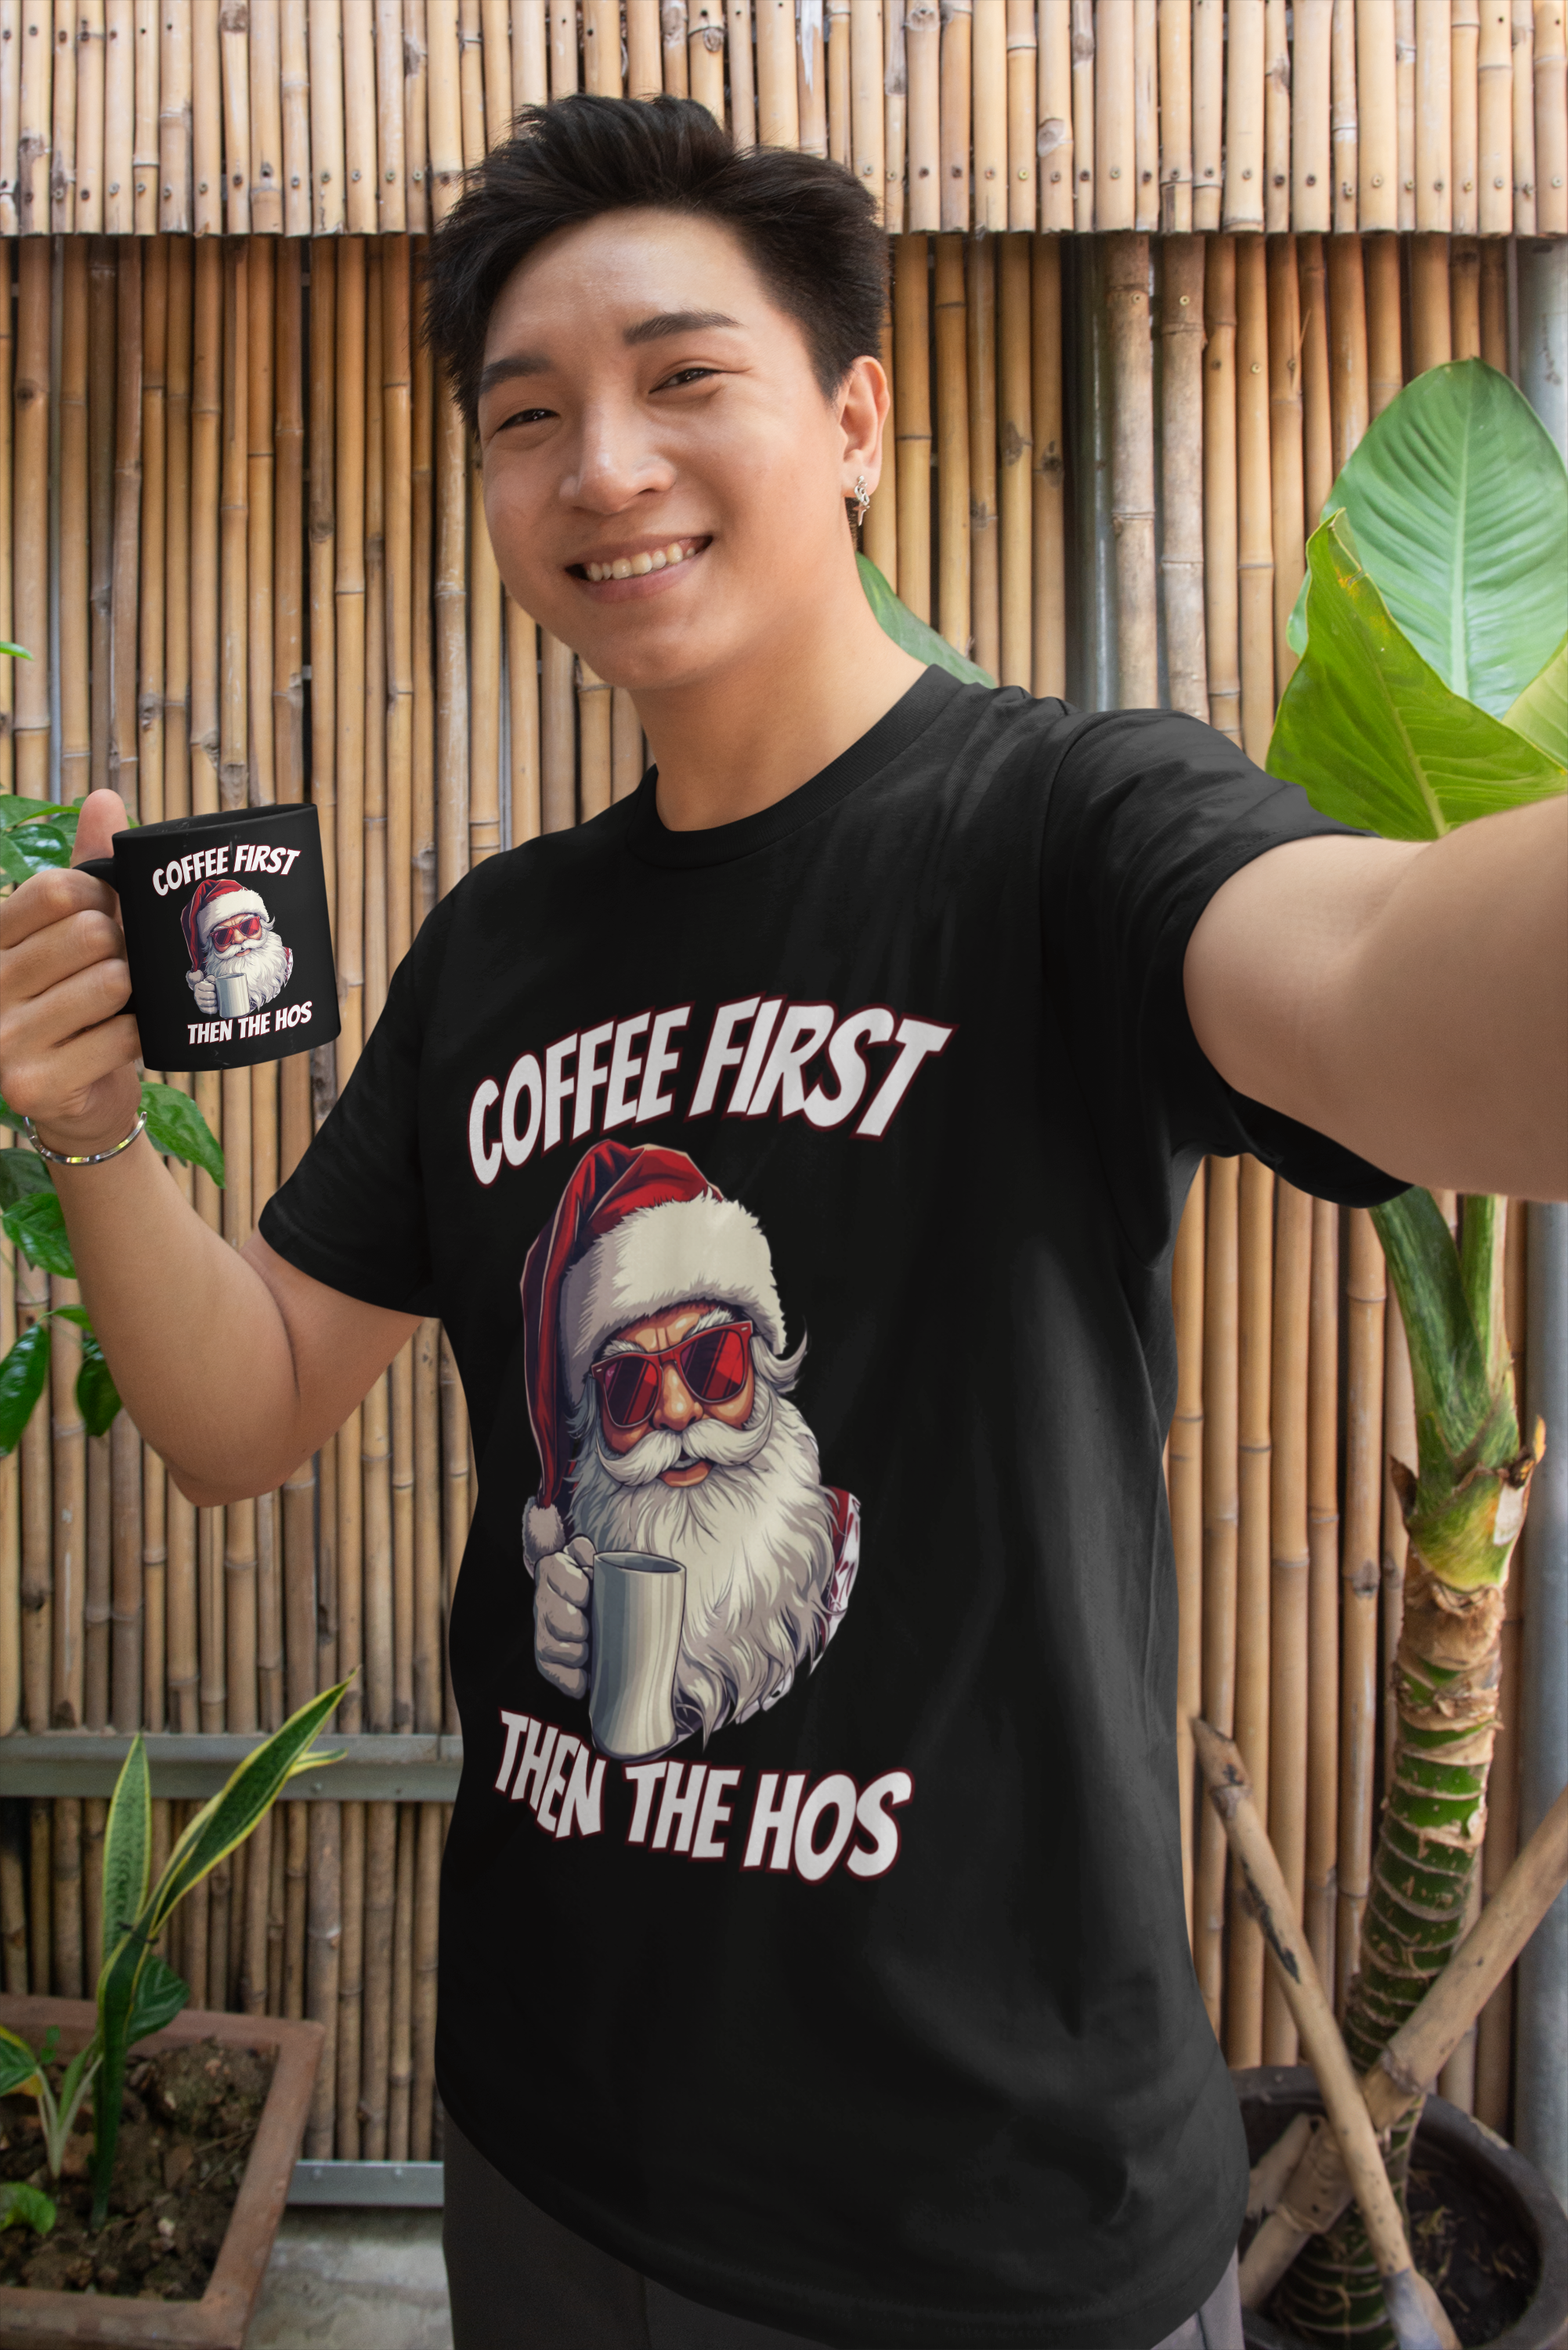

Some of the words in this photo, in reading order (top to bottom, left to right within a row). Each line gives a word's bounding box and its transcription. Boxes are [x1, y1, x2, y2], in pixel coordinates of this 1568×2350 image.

[152, 845, 229, 896] COFFEE
[233, 844, 301, 875] FIRST
[187, 1019, 233, 1044] THEN
[237, 1011, 271, 1039] THE
[275, 1000, 313, 1032] HOS
[468, 1004, 692, 1185] COFFEE
[687, 995, 954, 1138] FIRST
[493, 1709, 607, 1839] THEN
[624, 1759, 742, 1859] THE
[742, 1770, 913, 1882] HOS
